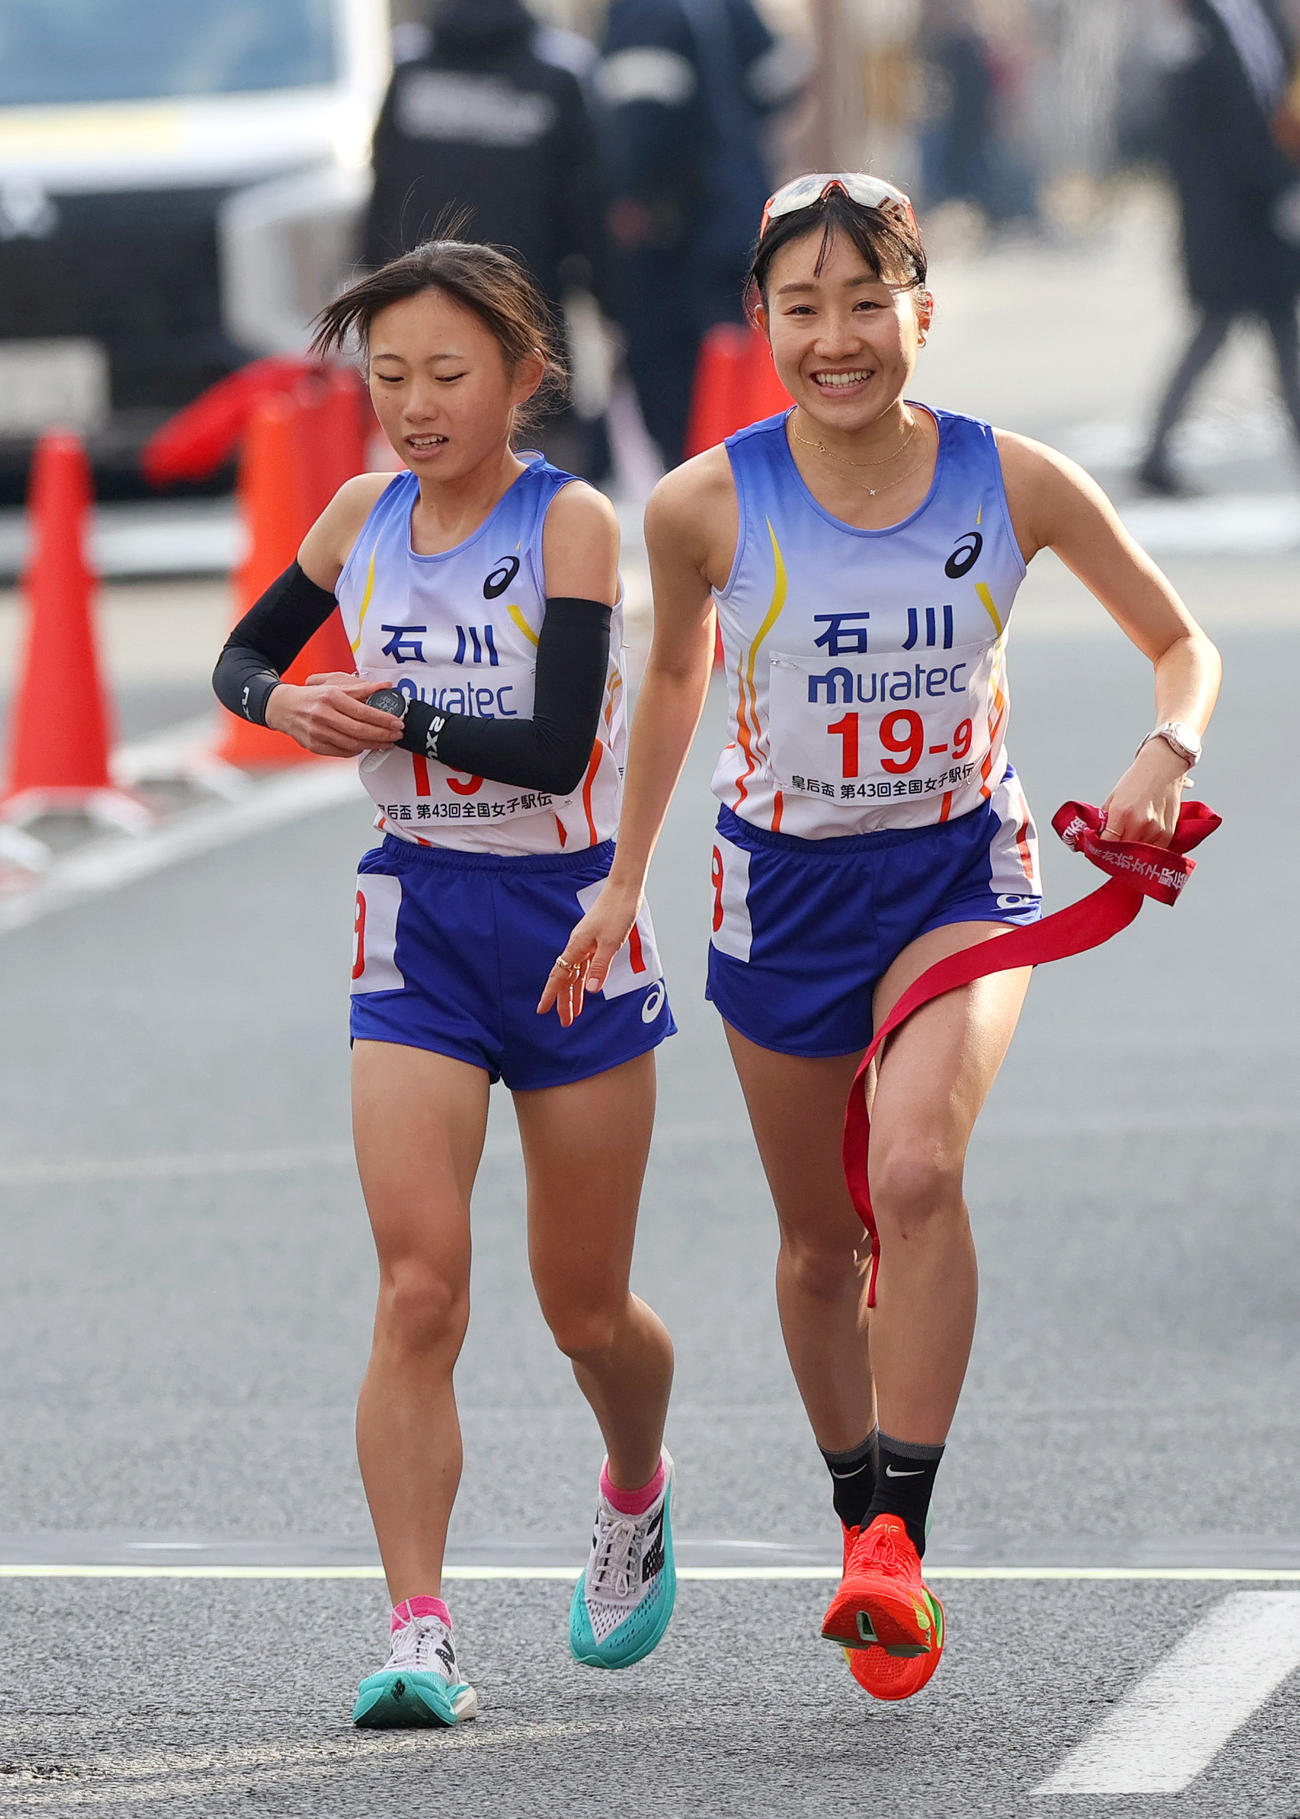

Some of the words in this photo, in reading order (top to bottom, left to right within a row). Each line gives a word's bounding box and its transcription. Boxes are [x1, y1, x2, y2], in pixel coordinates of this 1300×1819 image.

[381, 624, 499, 666] 石川
[813, 605, 954, 656] 石川
[827, 709, 973, 778] 19-9
[840, 763, 975, 799] 第43回全国女子駅伝
[416, 792, 553, 820] 第43回全国女子駅伝
